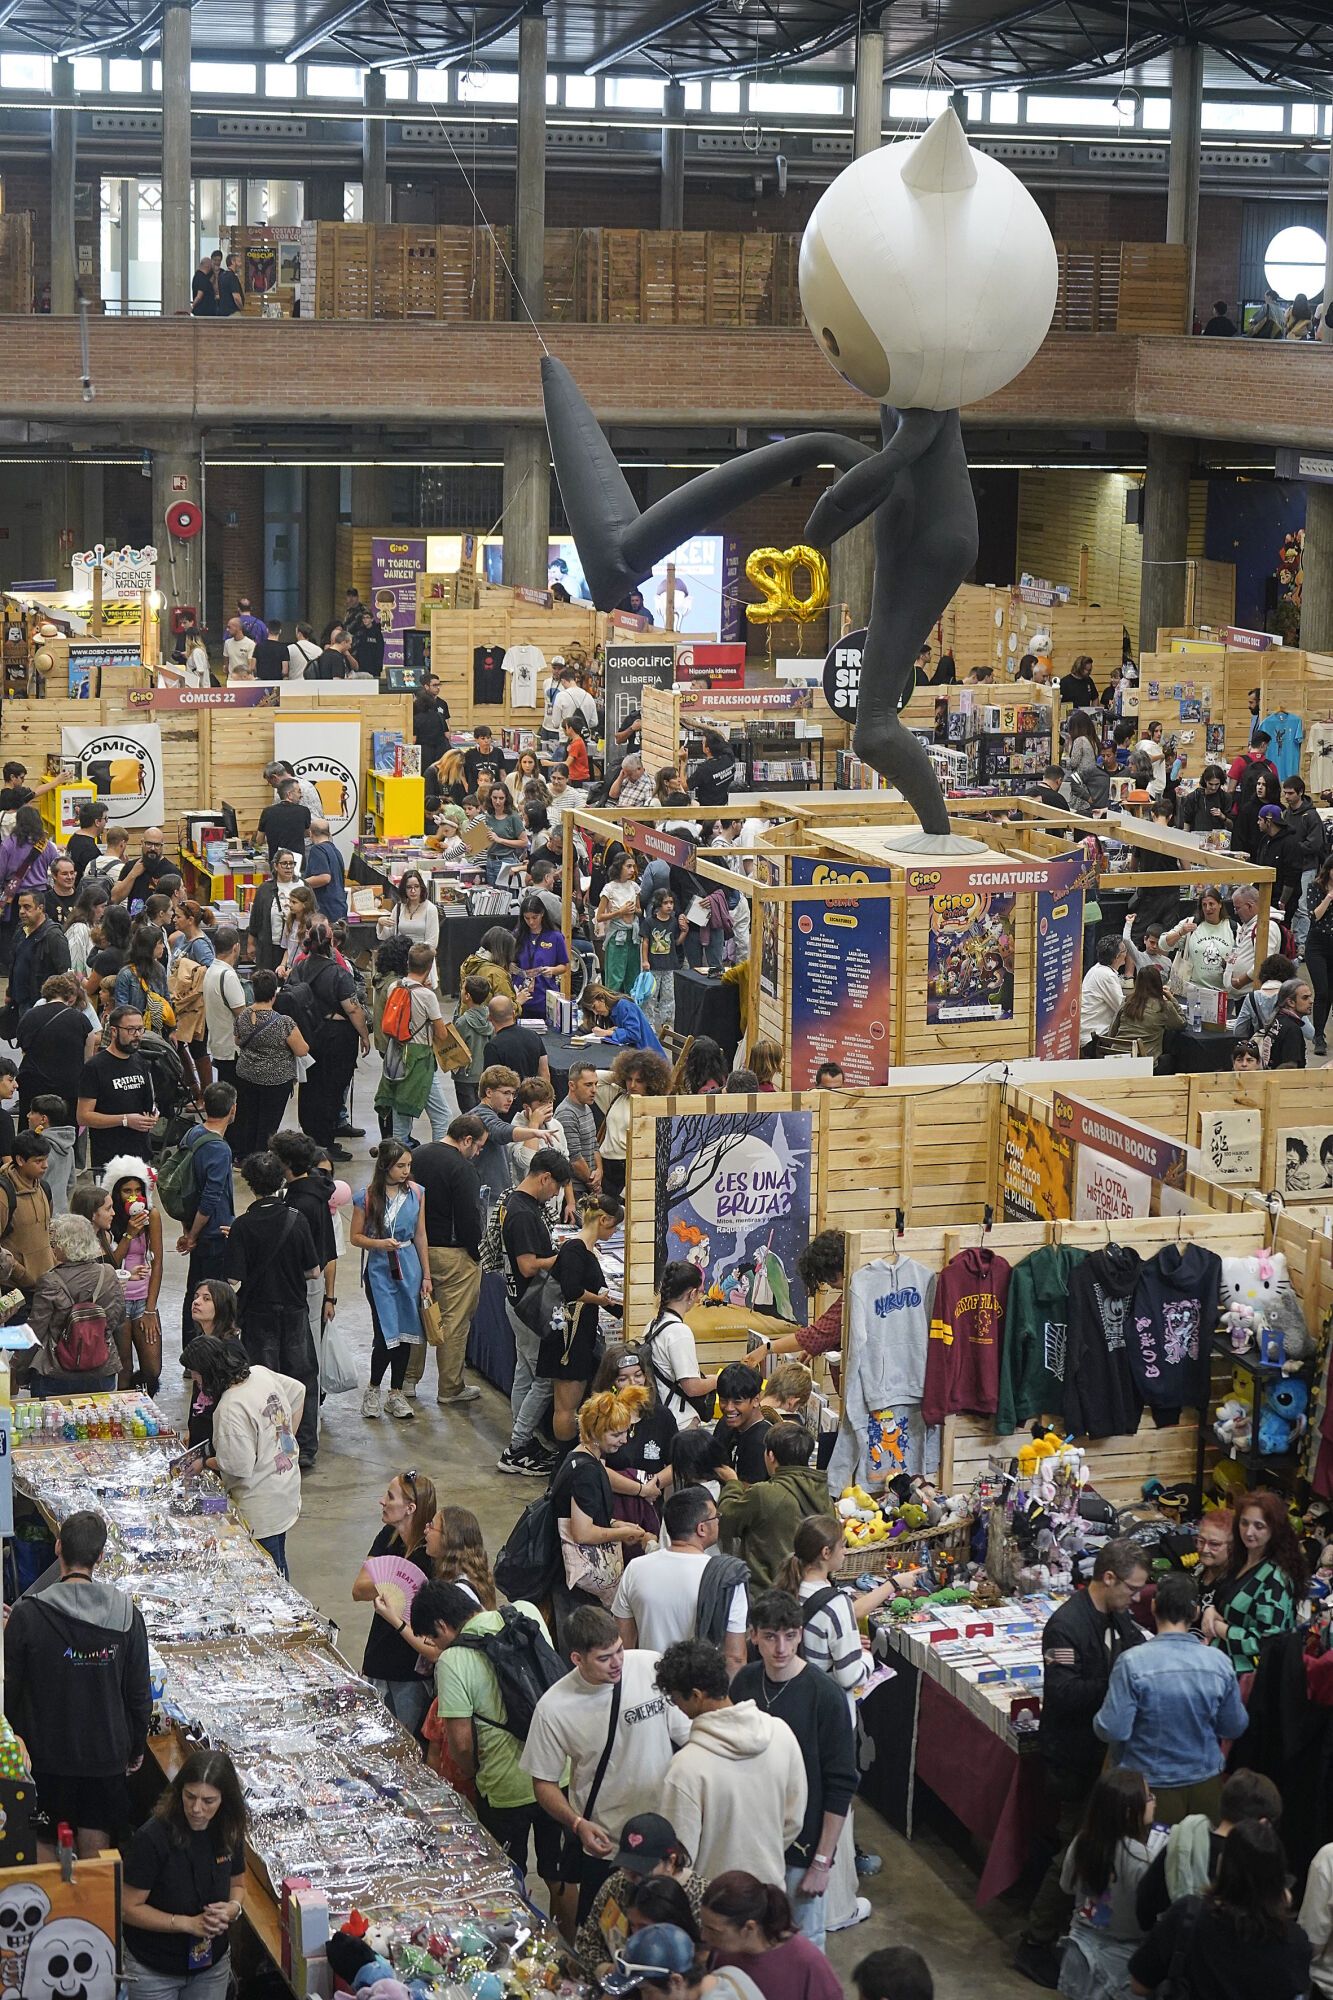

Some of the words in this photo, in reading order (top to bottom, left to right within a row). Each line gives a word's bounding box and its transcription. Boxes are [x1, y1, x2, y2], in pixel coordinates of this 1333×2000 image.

[388, 559, 421, 569] TORNEIG
[115, 571, 152, 580] SCIENCE
[384, 570, 414, 579] JANKEN
[115, 580, 151, 589] MANGA
[835, 649, 864, 667] FR
[179, 692, 221, 703] CÒMICS
[223, 693, 236, 702] 22
[702, 694, 760, 705] FREAKSHOW
[762, 692, 792, 704] STORE
[82, 741, 146, 762] CÒMICS
[296, 762, 350, 782] ÒMICS
[645, 834, 676, 857] SIGNATURES
[968, 871, 1048, 886] SIGNATURES
[112, 1075, 145, 1090] RATAFIA
[1006, 1141, 1024, 1160] CÓMO
[1082, 1116, 1124, 1151] GARBUIX
[1125, 1136, 1158, 1166] BOOKS
[715, 1172, 748, 1194] ¿ES
[752, 1168, 791, 1190] UNA
[1009, 1158, 1021, 1175] LOS
[1022, 1165, 1041, 1185] RICOS
[1006, 1172, 1033, 1197] SAQUEAN
[1095, 1171, 1103, 1187] LA
[1106, 1178, 1128, 1202] OTRA
[717, 1192, 793, 1217] BRUJA?
[1004, 1186, 1010, 1200] EL
[1011, 1189, 1037, 1215] PLANETA
[1087, 1184, 1119, 1215] HISTORIA
[396, 1571, 414, 1584] HEAT
